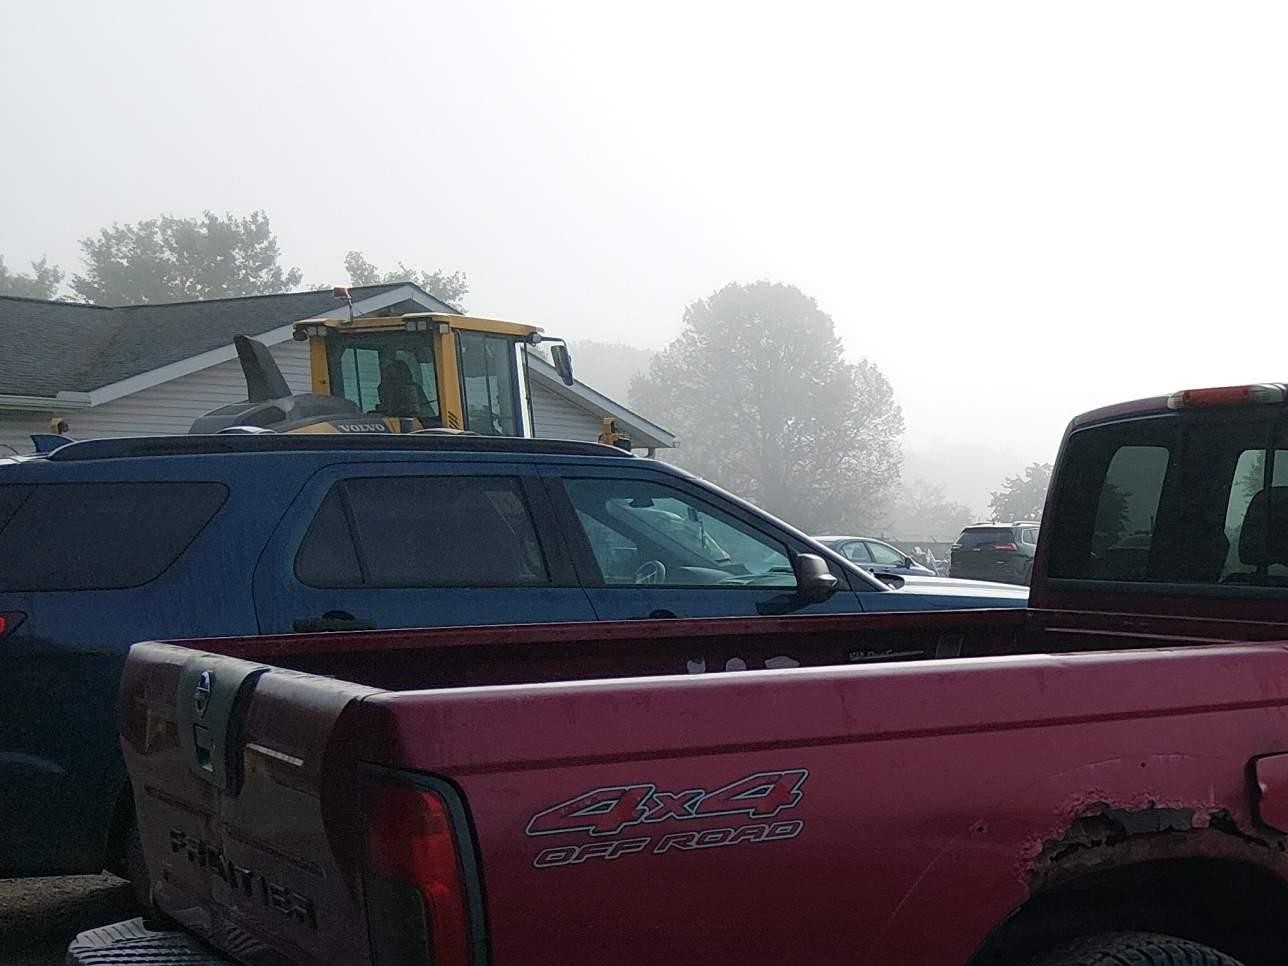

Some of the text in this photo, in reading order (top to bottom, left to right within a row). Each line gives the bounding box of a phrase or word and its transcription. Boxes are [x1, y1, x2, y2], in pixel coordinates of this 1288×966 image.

[338, 423, 385, 432] VOLVO
[525, 768, 809, 837] 4x4
[532, 820, 804, 868] OFF ROAD
